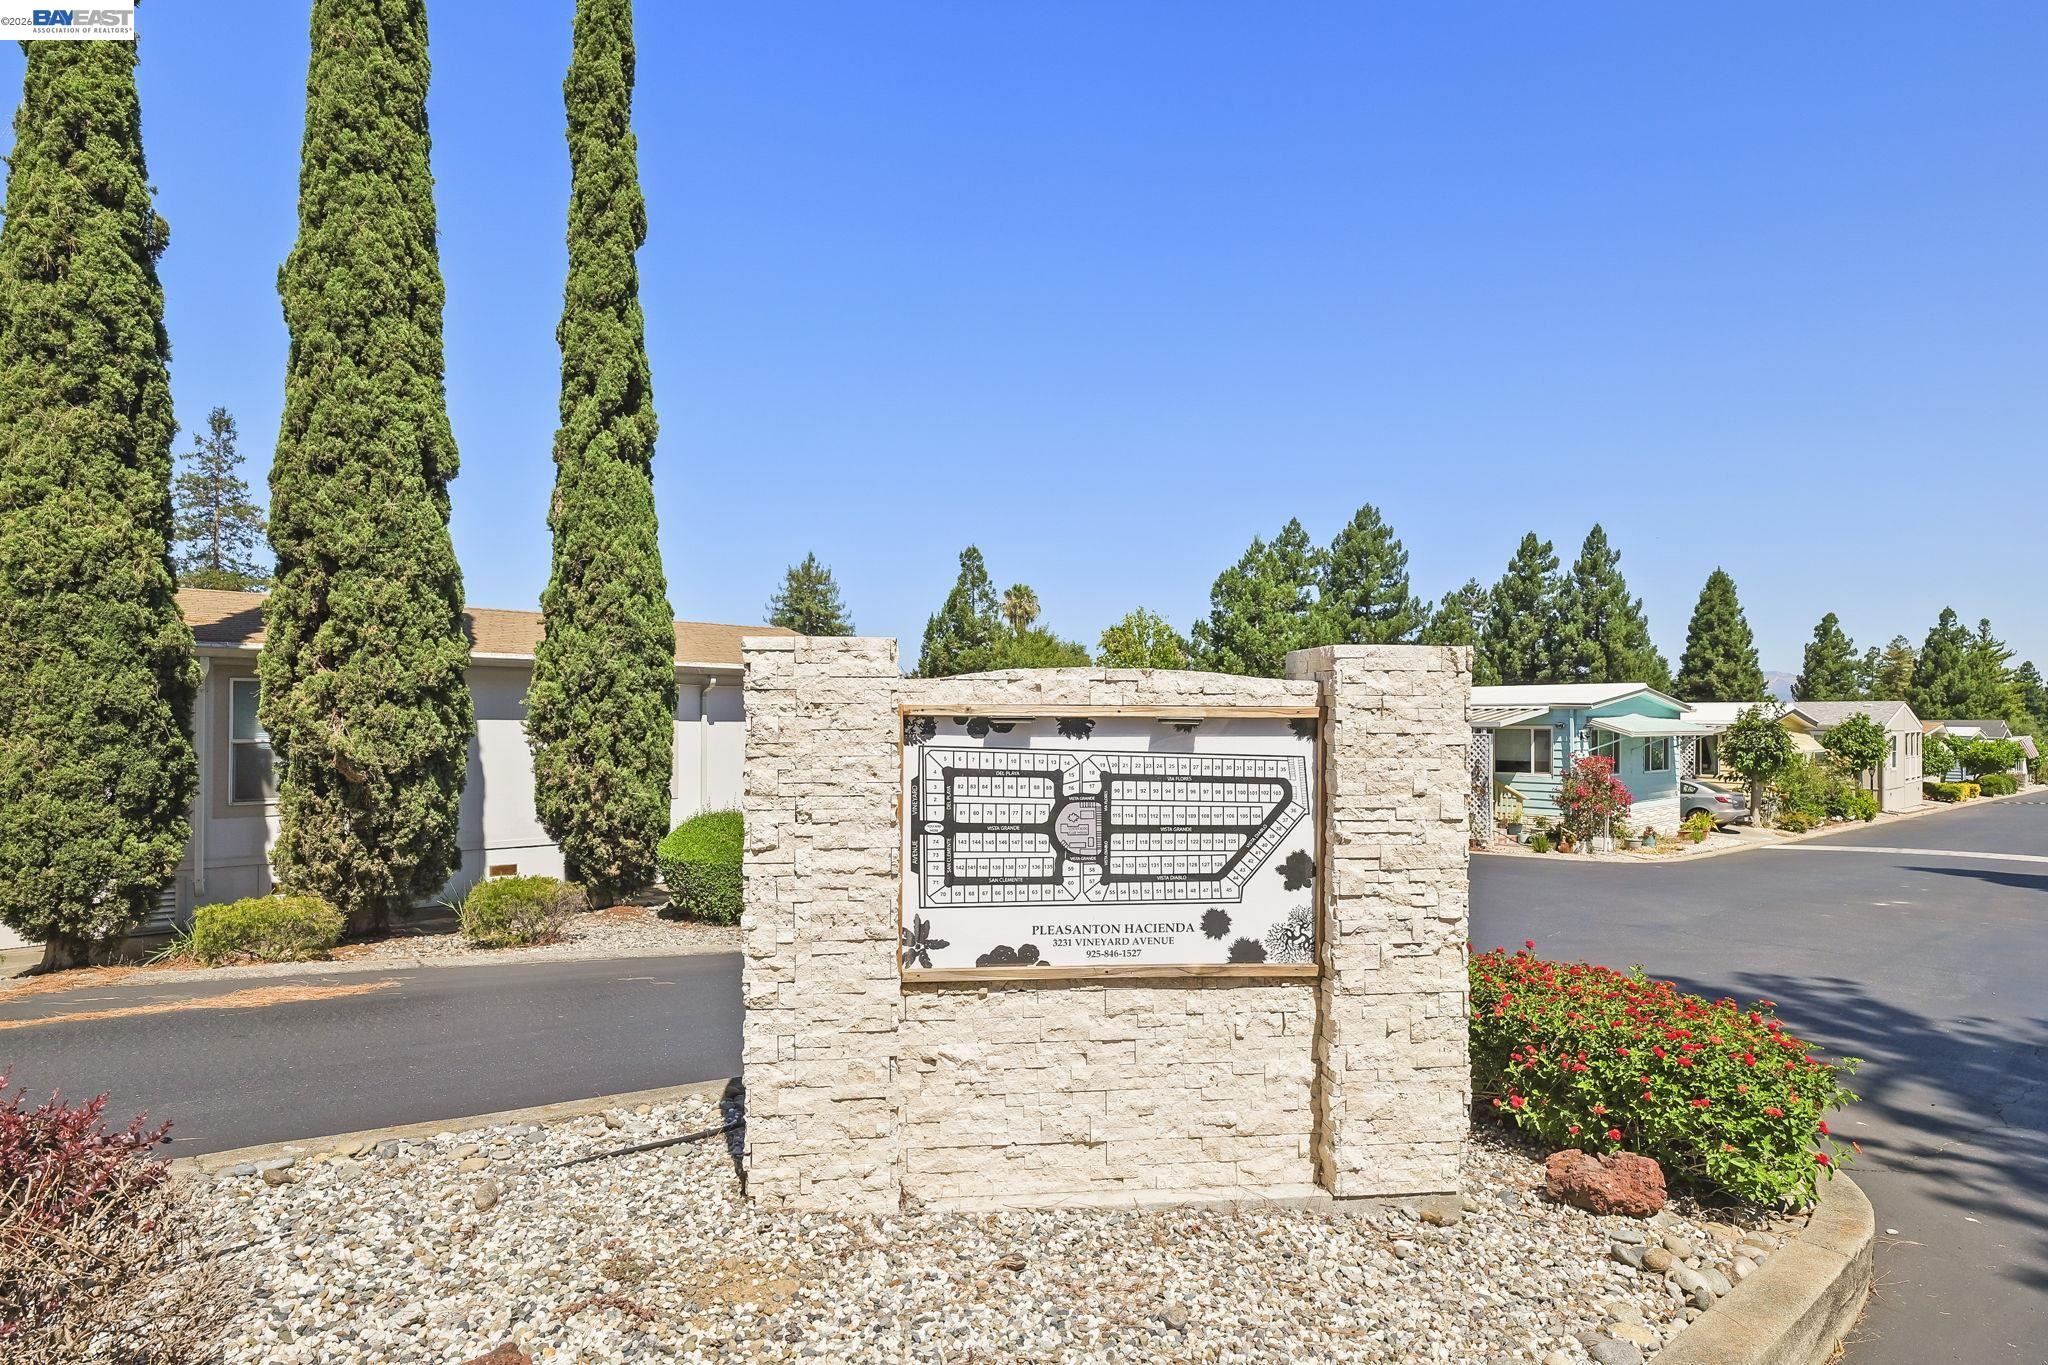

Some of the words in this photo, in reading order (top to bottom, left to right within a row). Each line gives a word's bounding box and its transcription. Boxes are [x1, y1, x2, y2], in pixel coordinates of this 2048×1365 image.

[1245, 837, 1257, 848] VISTA
[1032, 924, 1120, 935] PLEASANTON
[1125, 923, 1195, 934] HACIENDA
[1052, 939, 1072, 947] 3231
[1075, 938, 1130, 946] VINEYARD
[1132, 936, 1174, 945] AVENUE
[1086, 949, 1142, 958] 925-846-1527
